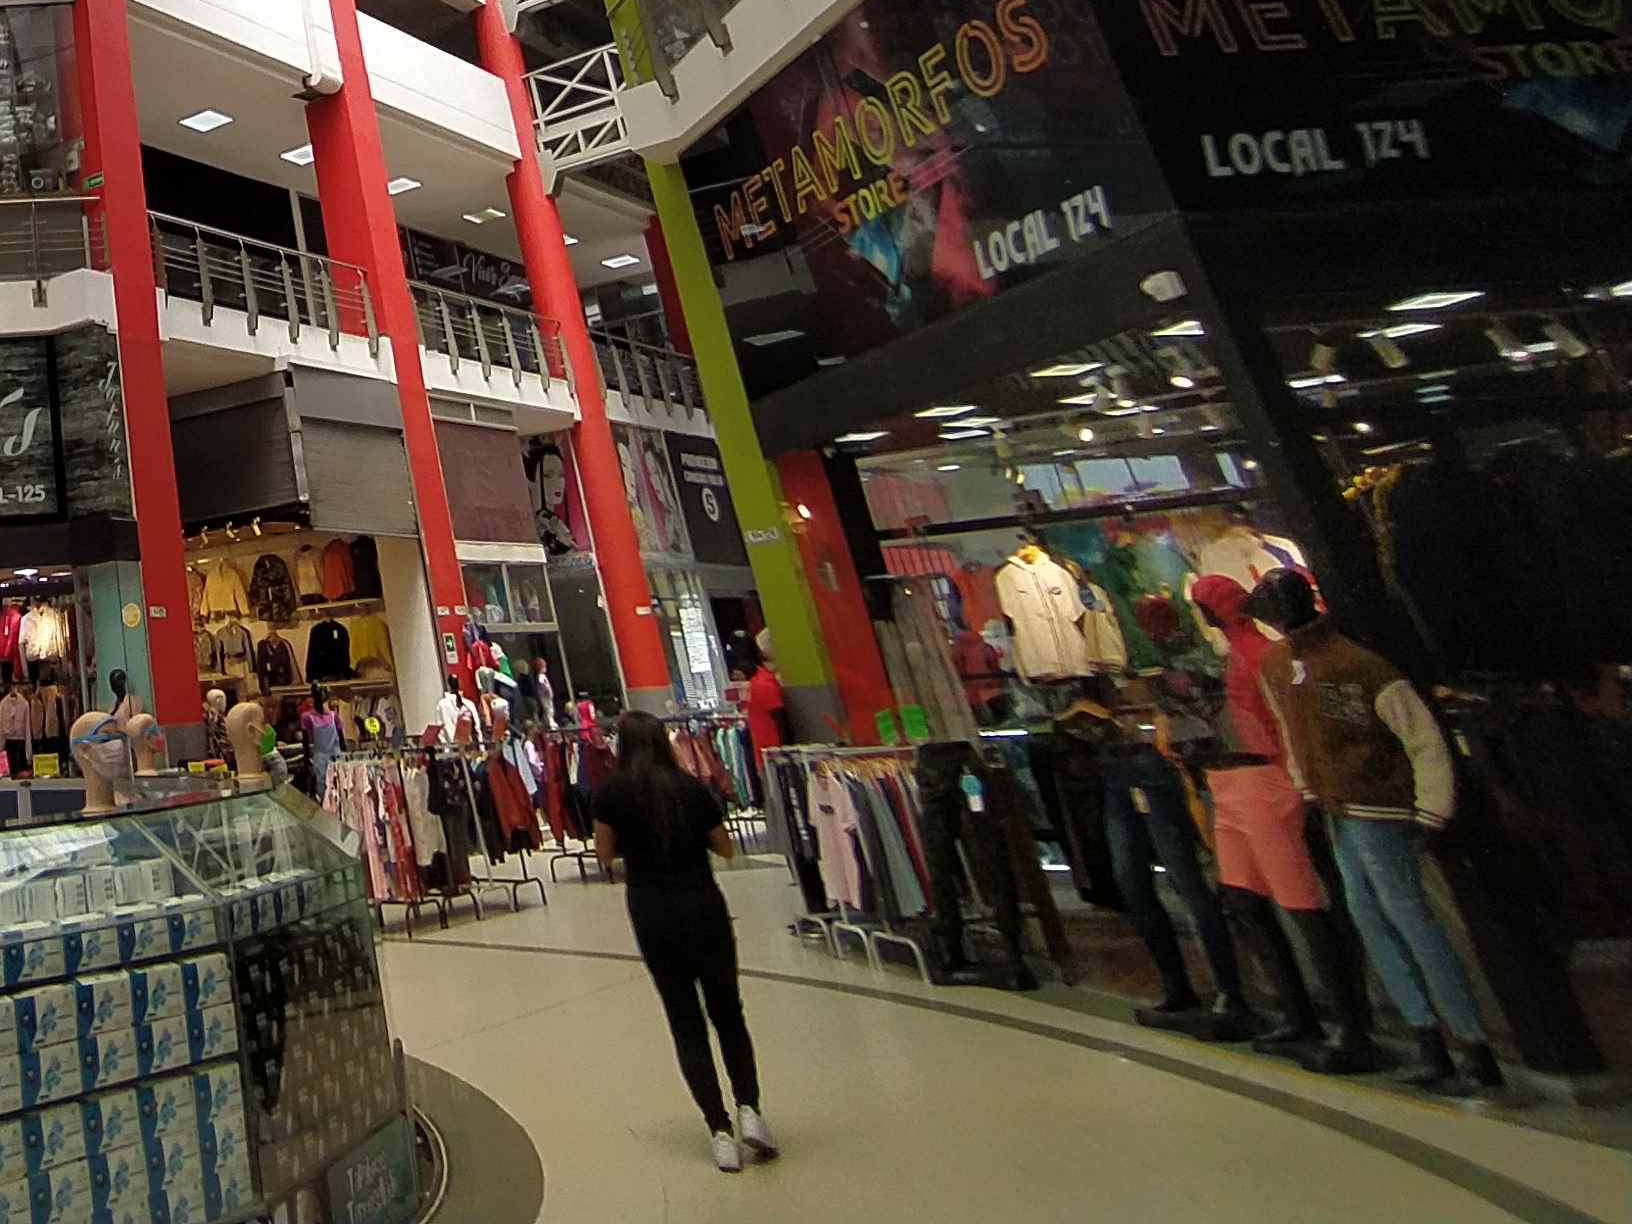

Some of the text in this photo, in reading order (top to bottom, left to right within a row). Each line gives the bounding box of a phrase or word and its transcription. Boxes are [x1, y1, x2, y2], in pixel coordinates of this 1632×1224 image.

[1200, 119, 1431, 177] LOCAL 124
[834, 171, 909, 235] STORE
[974, 184, 1114, 280] LOCAL 124
